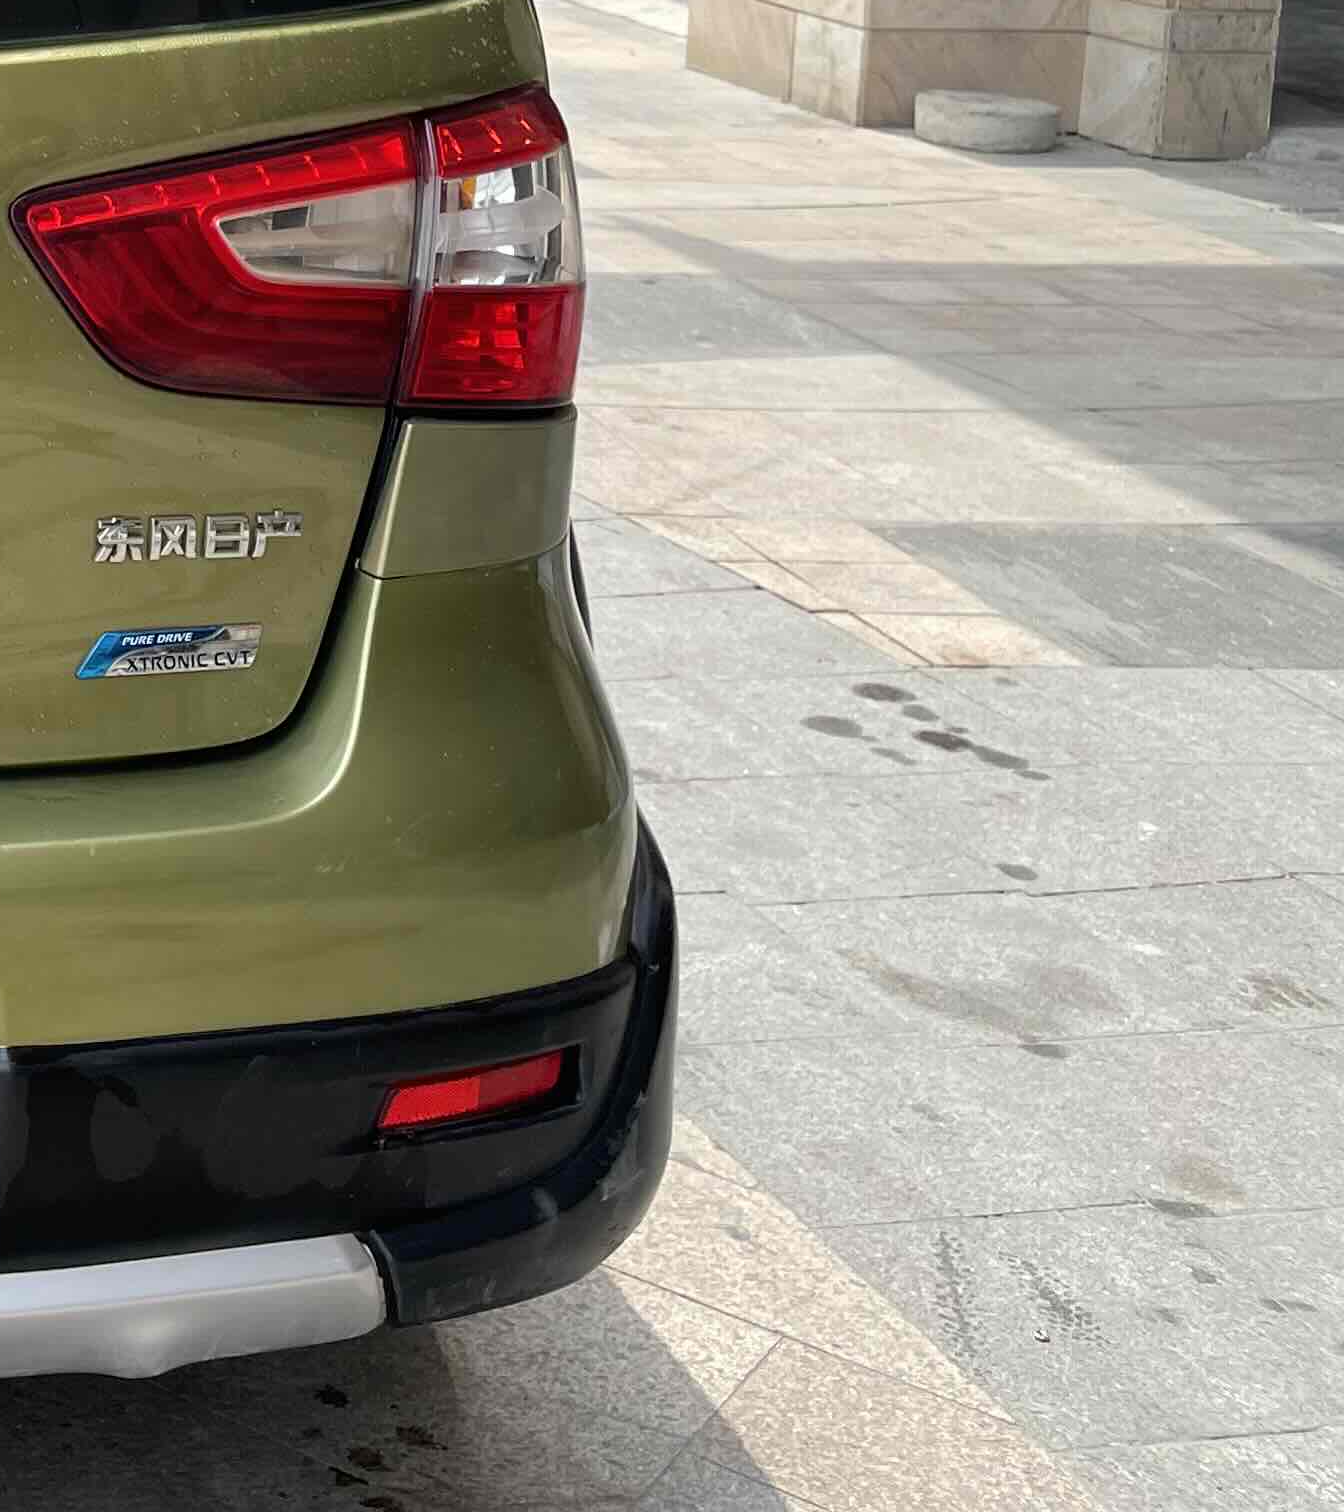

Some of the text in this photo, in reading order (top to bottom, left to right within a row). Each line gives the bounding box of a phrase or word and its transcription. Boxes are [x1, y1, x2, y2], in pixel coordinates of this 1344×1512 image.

[93, 509, 304, 563] 东风日产
[121, 632, 193, 647] PURE DRIVE
[127, 651, 252, 673] XTRONIC CVT
